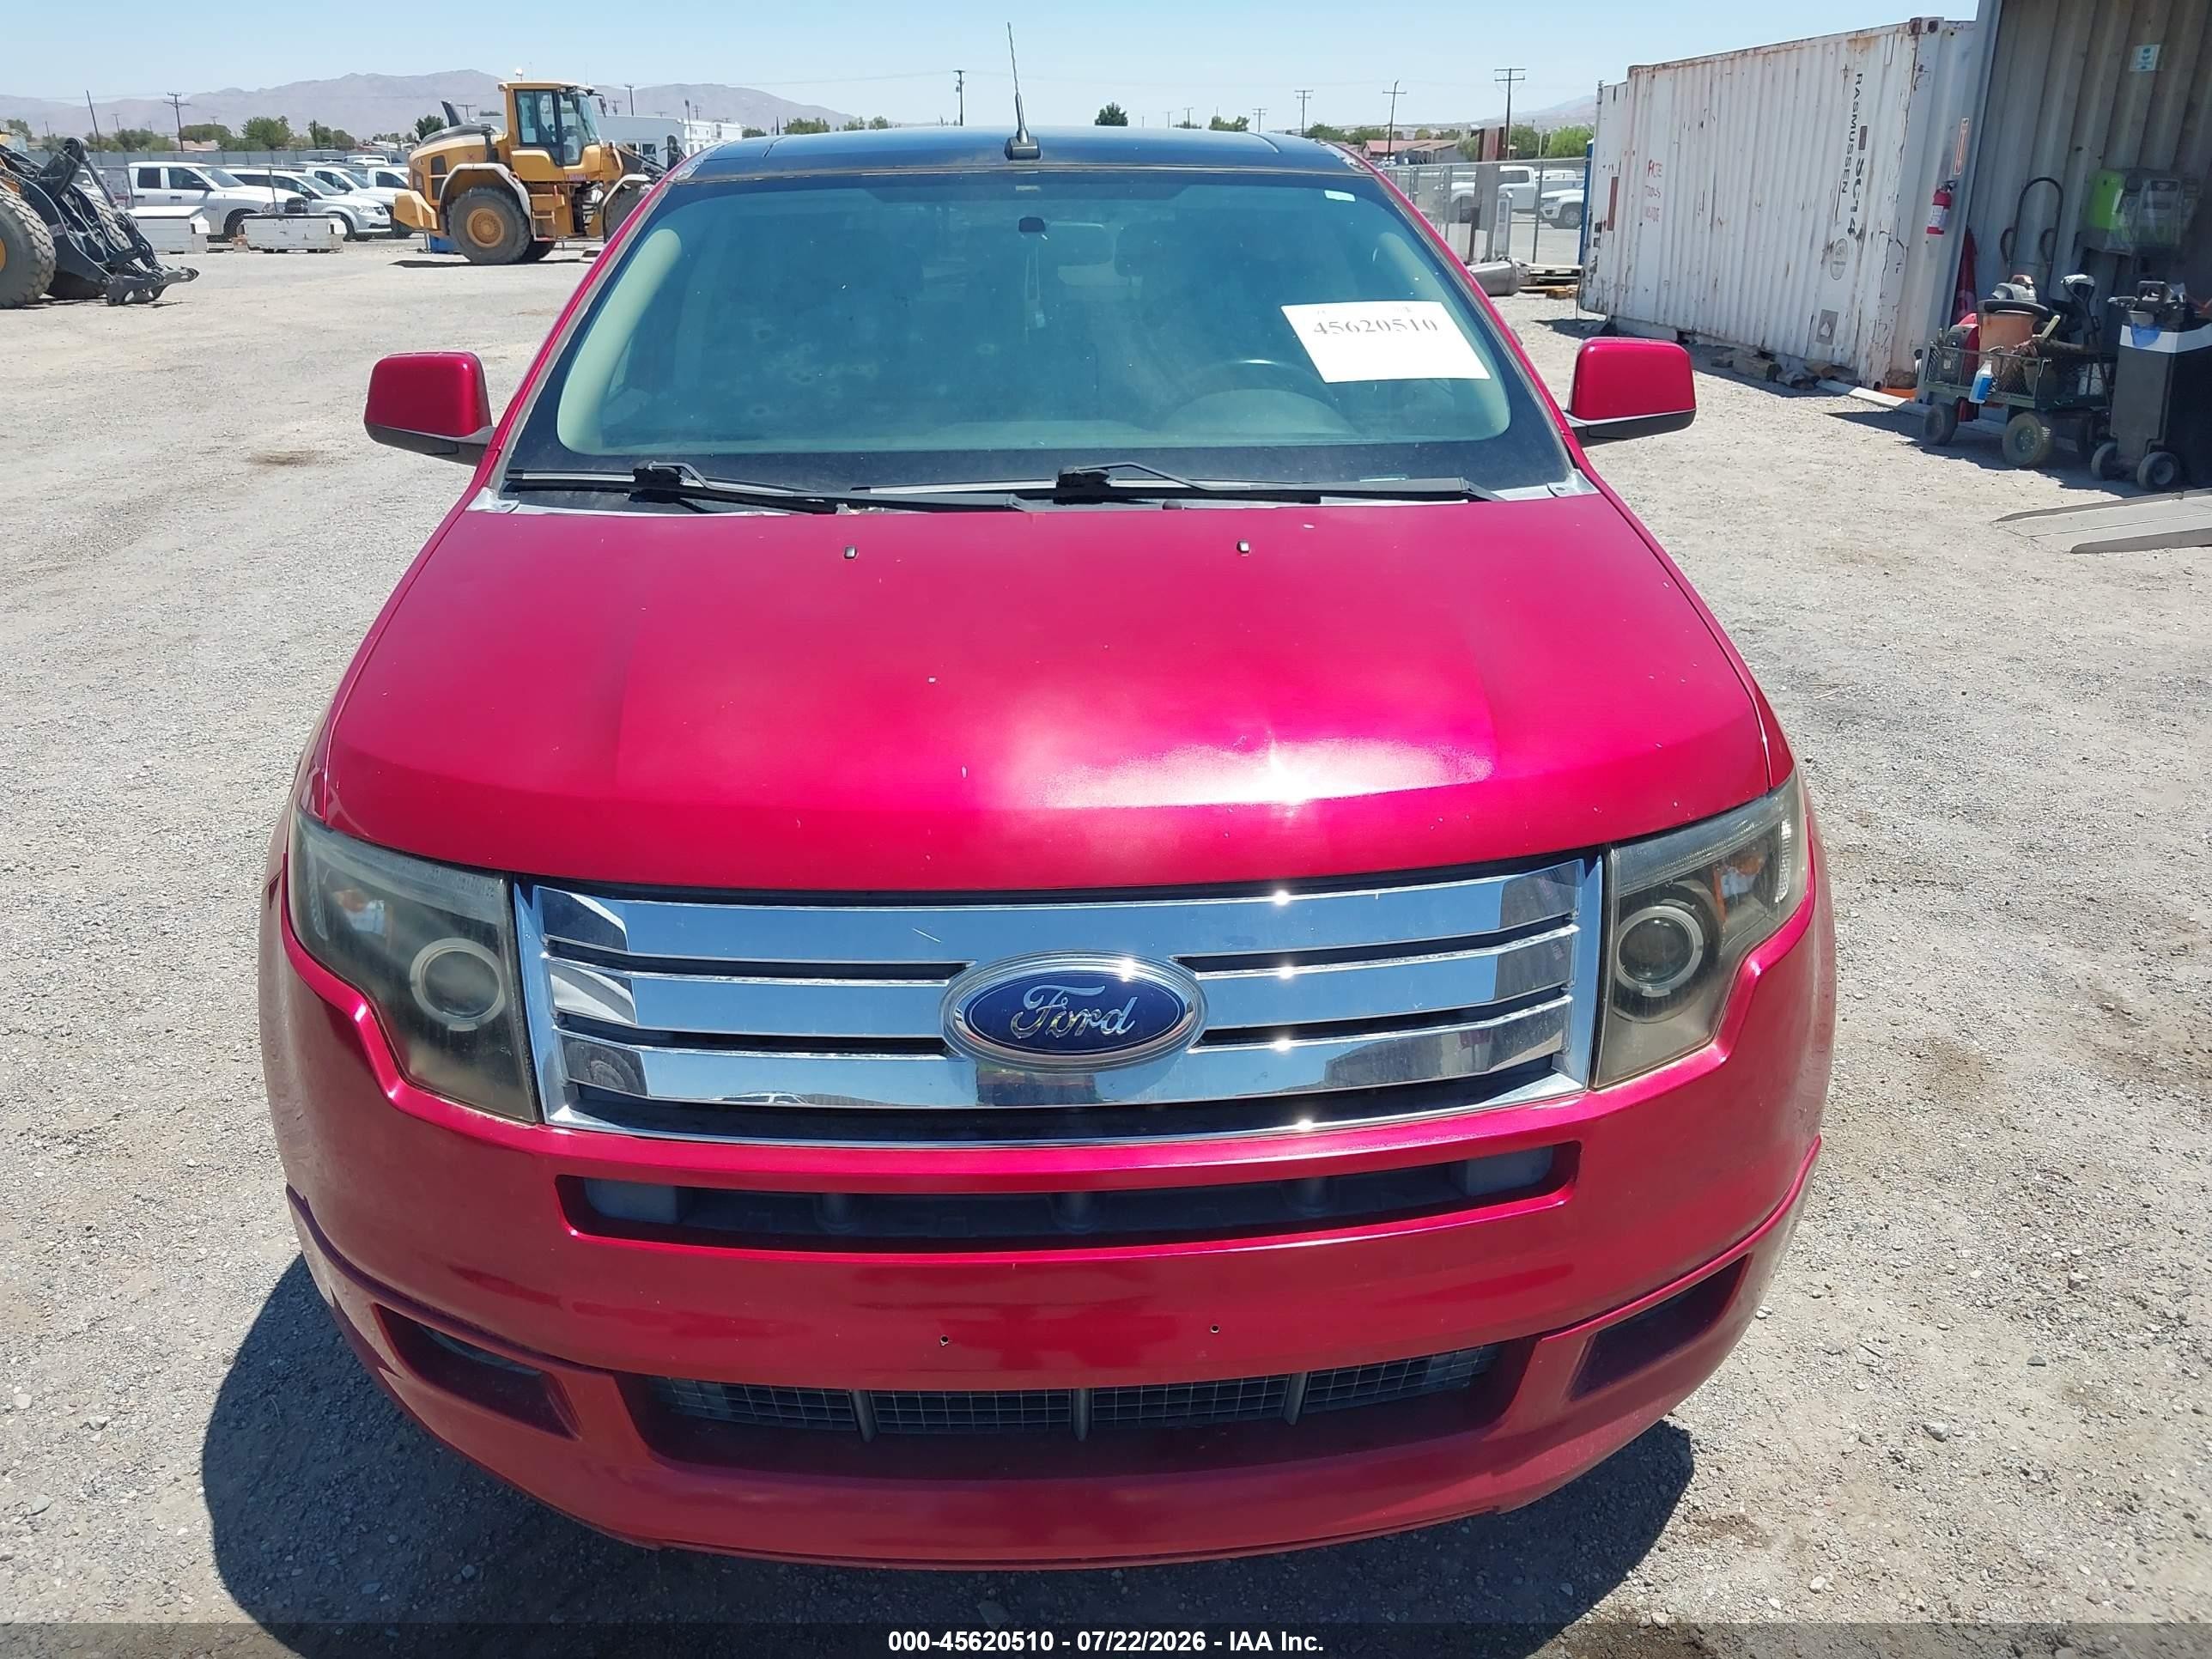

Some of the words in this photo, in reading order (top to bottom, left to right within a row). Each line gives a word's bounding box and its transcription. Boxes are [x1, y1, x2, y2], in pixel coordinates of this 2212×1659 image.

[1841, 73, 1863, 193] RASMUSSEN
[1313, 319, 1438, 335] 45620510
[1010, 984, 1139, 1040] Ford
